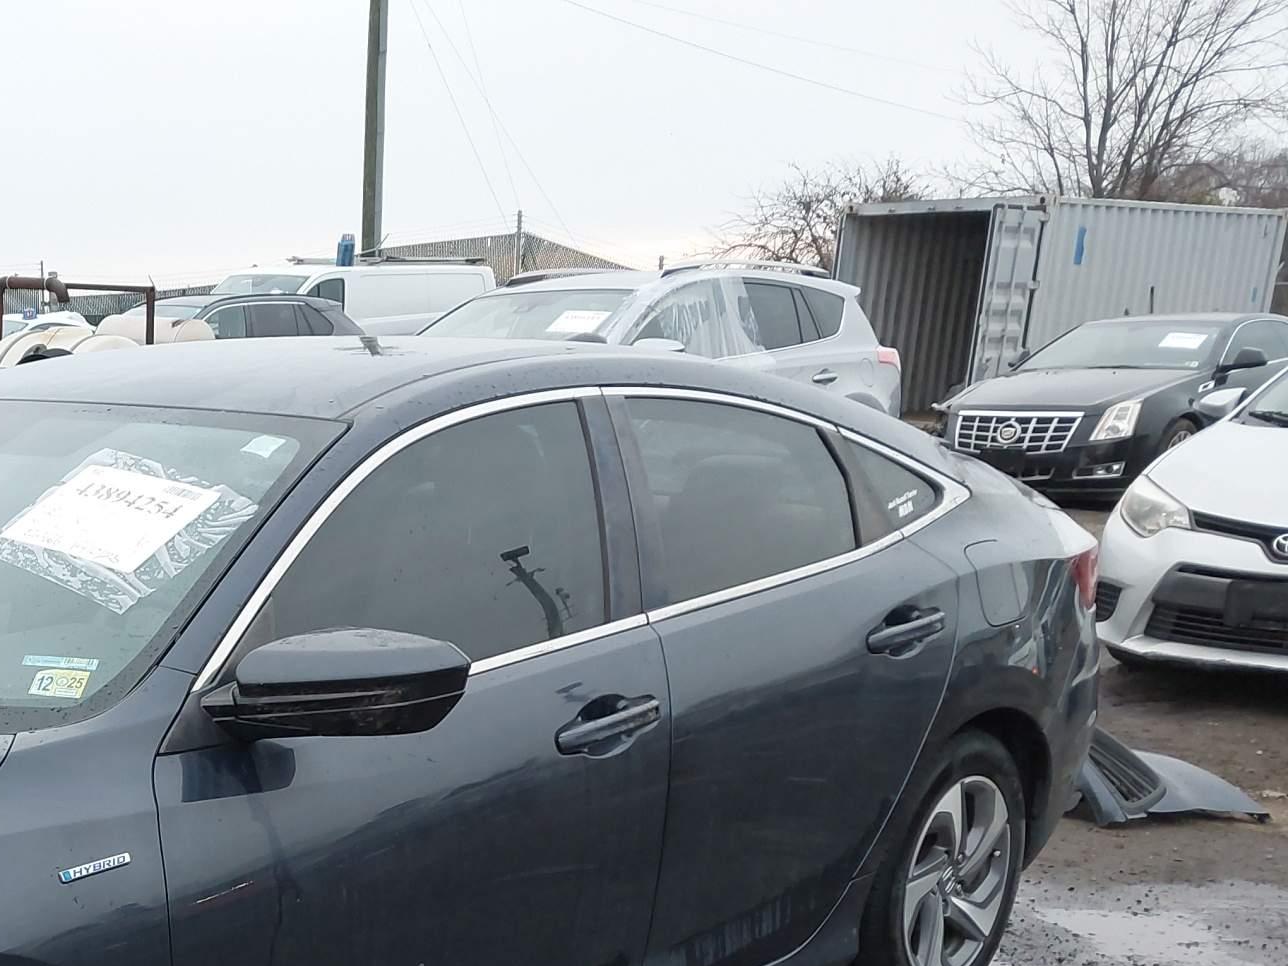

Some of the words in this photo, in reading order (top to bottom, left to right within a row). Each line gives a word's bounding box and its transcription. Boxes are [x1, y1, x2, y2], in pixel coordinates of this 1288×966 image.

[75, 482, 184, 519] 43894254
[36, 675, 54, 692] 12
[67, 676, 85, 690] 25
[73, 855, 126, 878] HYBRID
